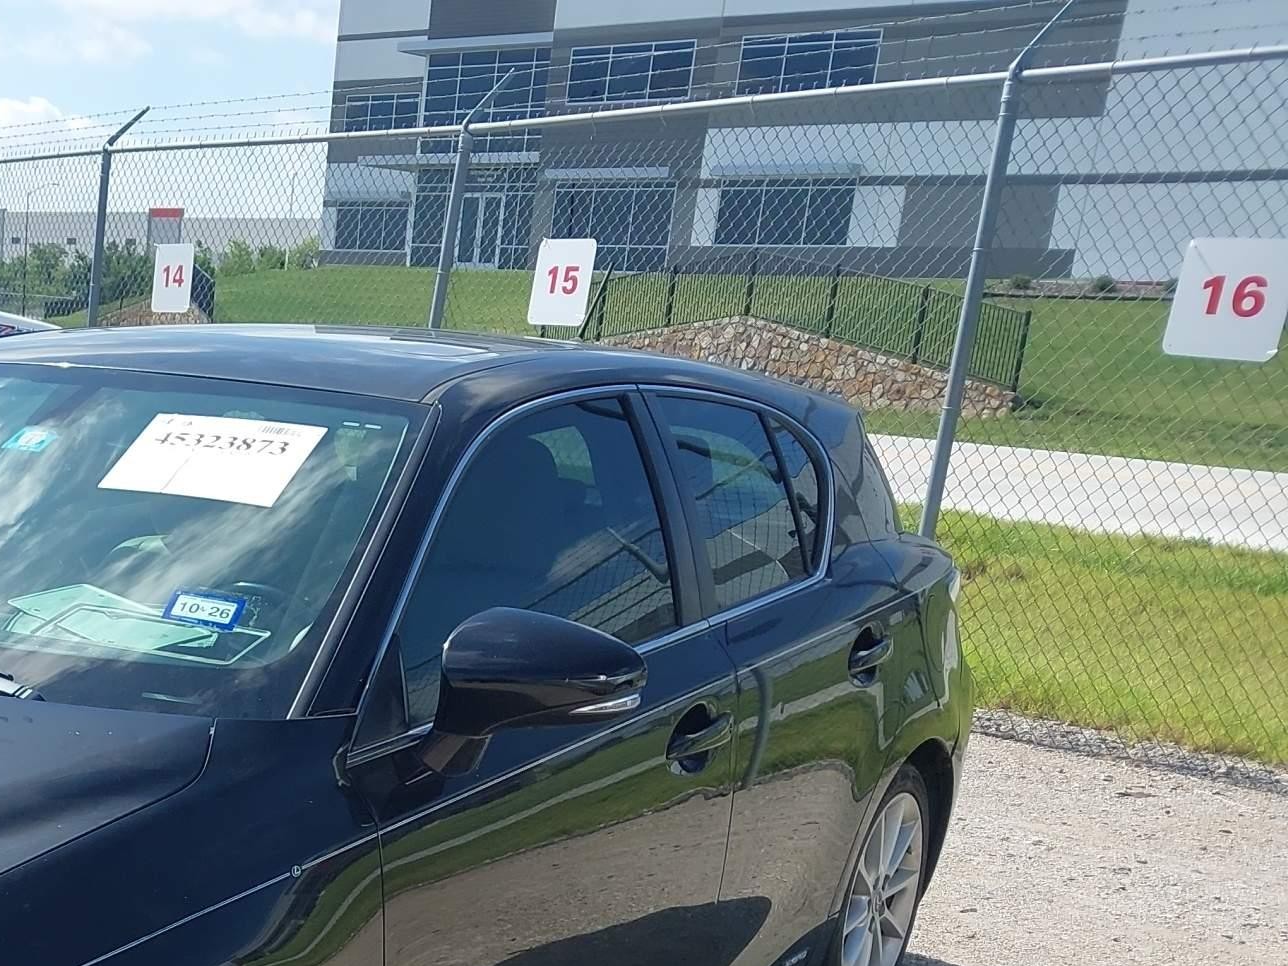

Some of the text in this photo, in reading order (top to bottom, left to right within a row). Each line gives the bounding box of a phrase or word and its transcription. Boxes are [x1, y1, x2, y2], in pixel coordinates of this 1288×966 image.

[162, 264, 185, 289] 14
[547, 265, 580, 295] 15
[1203, 275, 1269, 318] 16
[154, 431, 290, 456] 45323873
